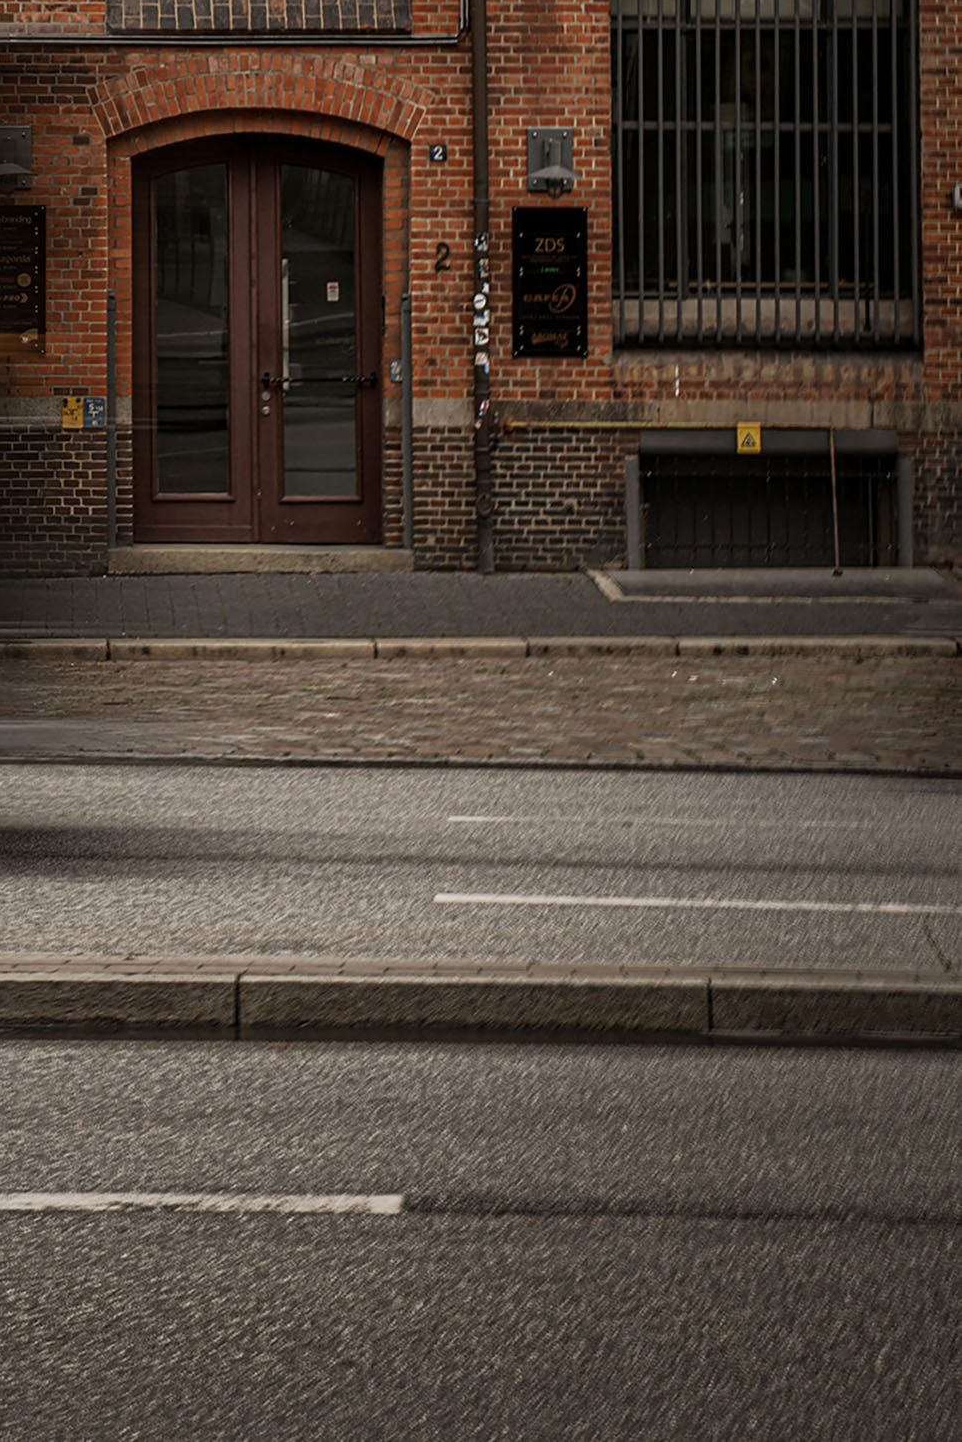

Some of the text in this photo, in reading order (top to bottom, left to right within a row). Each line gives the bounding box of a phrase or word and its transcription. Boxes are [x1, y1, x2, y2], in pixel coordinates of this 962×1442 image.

[433, 145, 444, 160] 2
[534, 237, 566, 253] ZDS
[435, 242, 450, 272] 2
